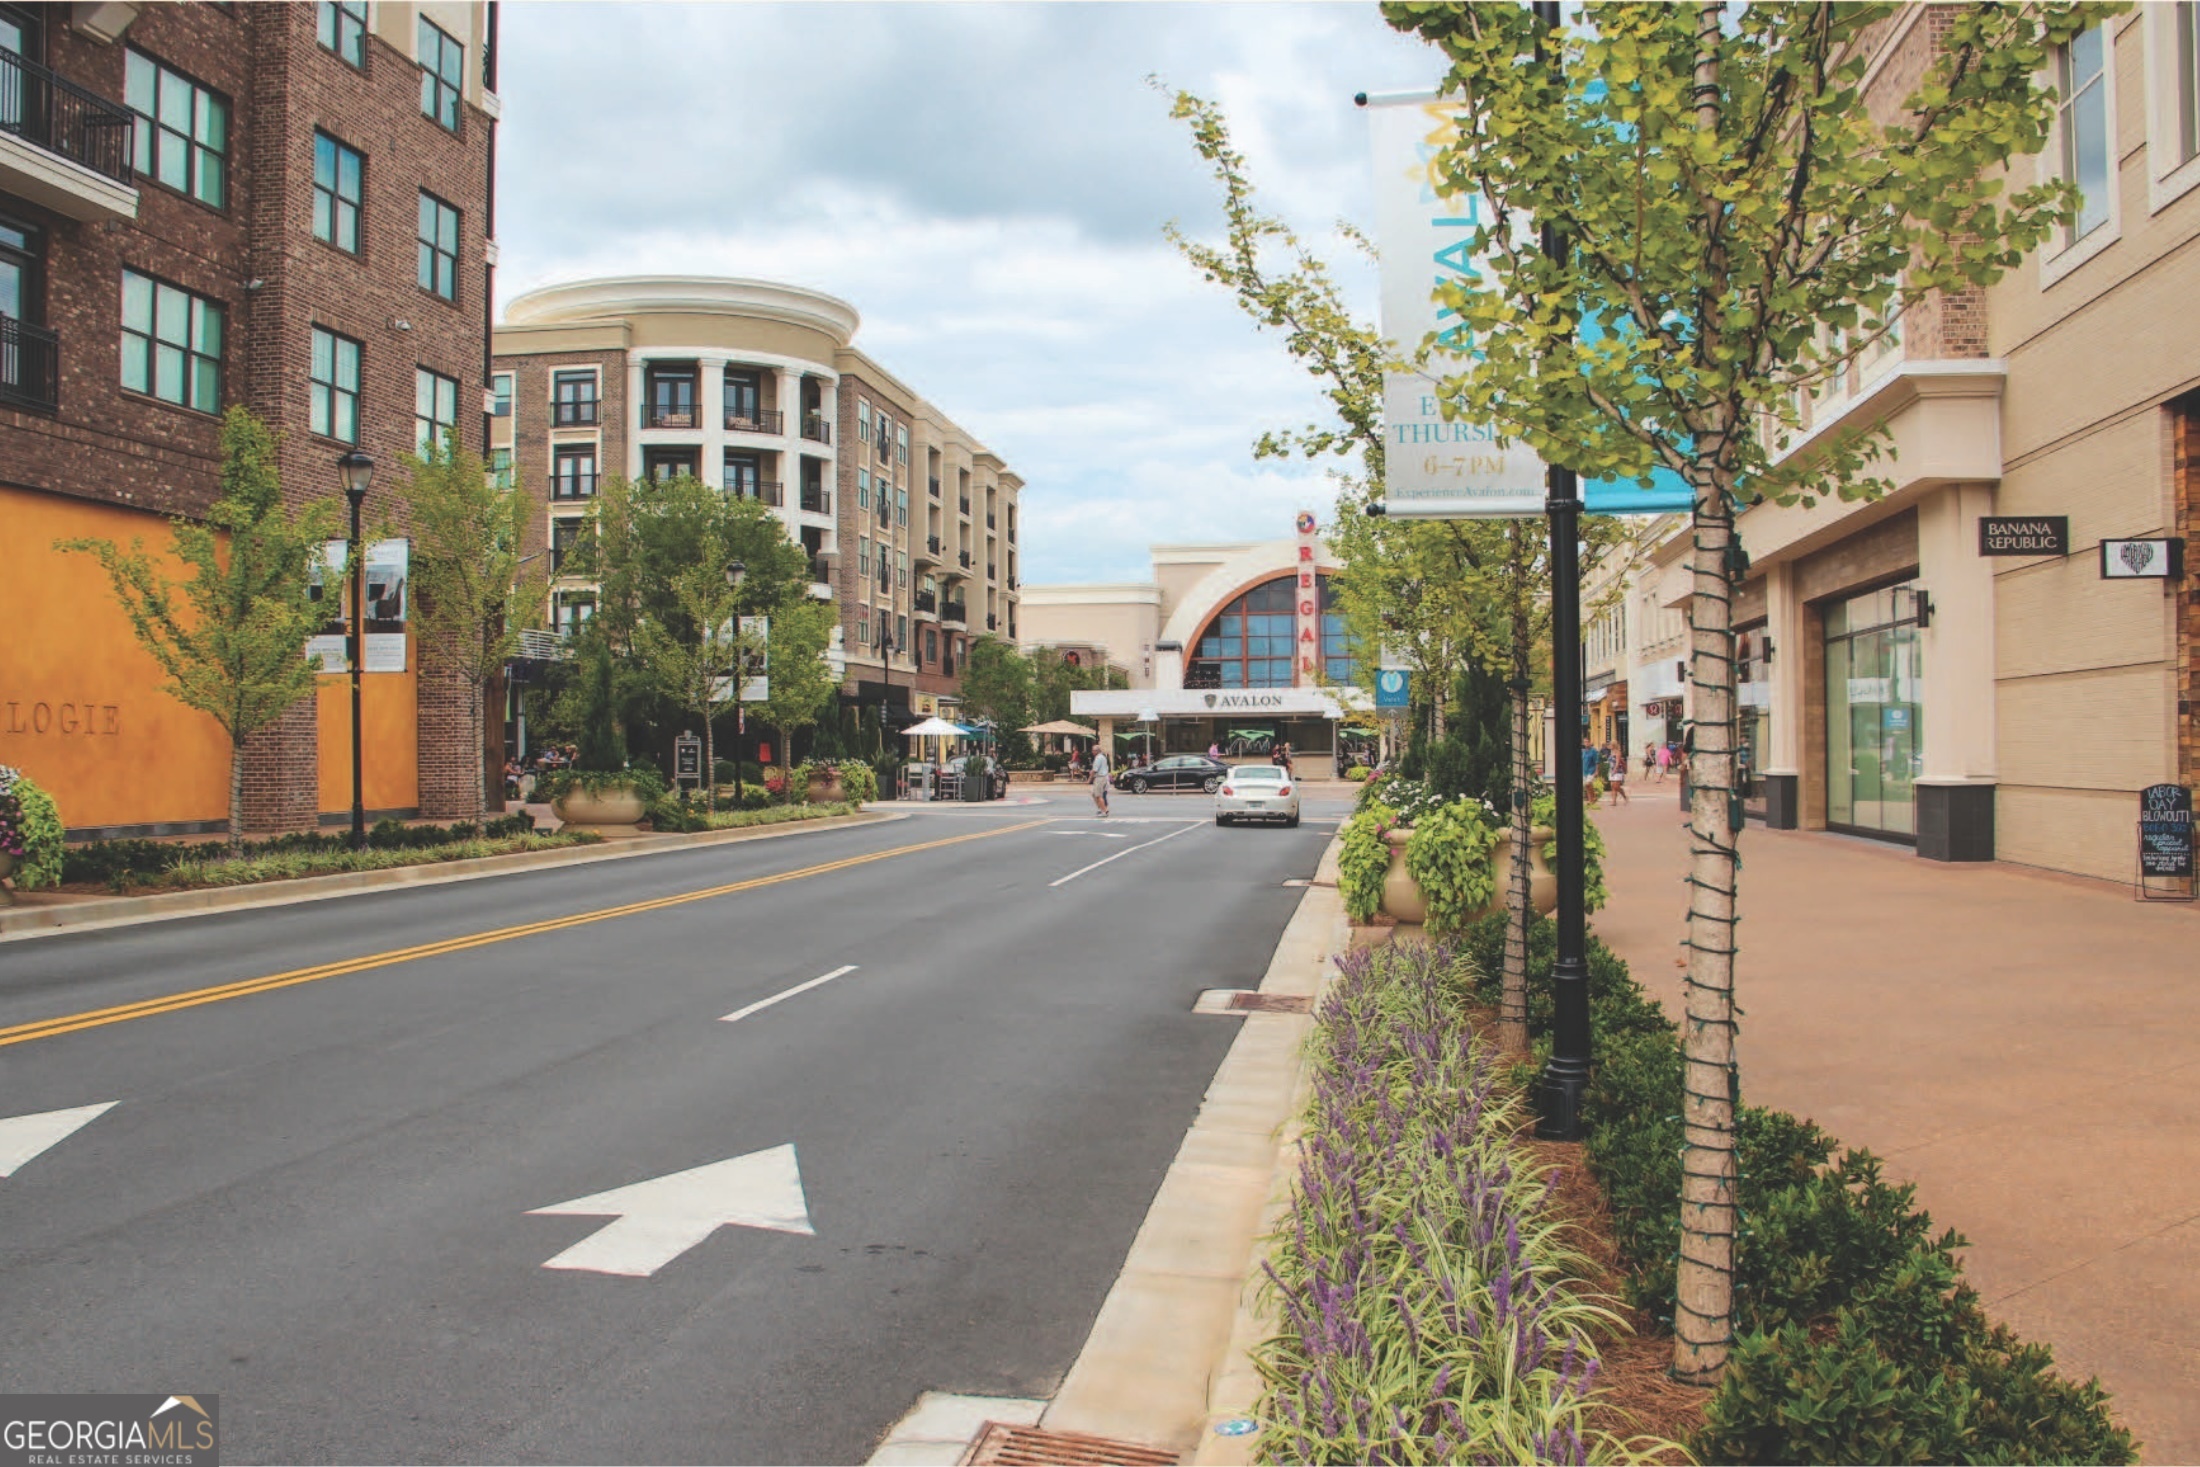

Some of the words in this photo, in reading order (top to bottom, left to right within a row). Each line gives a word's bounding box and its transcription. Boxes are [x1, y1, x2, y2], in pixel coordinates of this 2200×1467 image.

[1989, 523, 2052, 535] BANANA
[1987, 536, 2057, 549] REPUBLIC
[1299, 547, 1313, 671] REGAL
[1221, 695, 1282, 707] AVALON
[2147, 786, 2182, 800] LABOR
[2149, 798, 2176, 811] DAY
